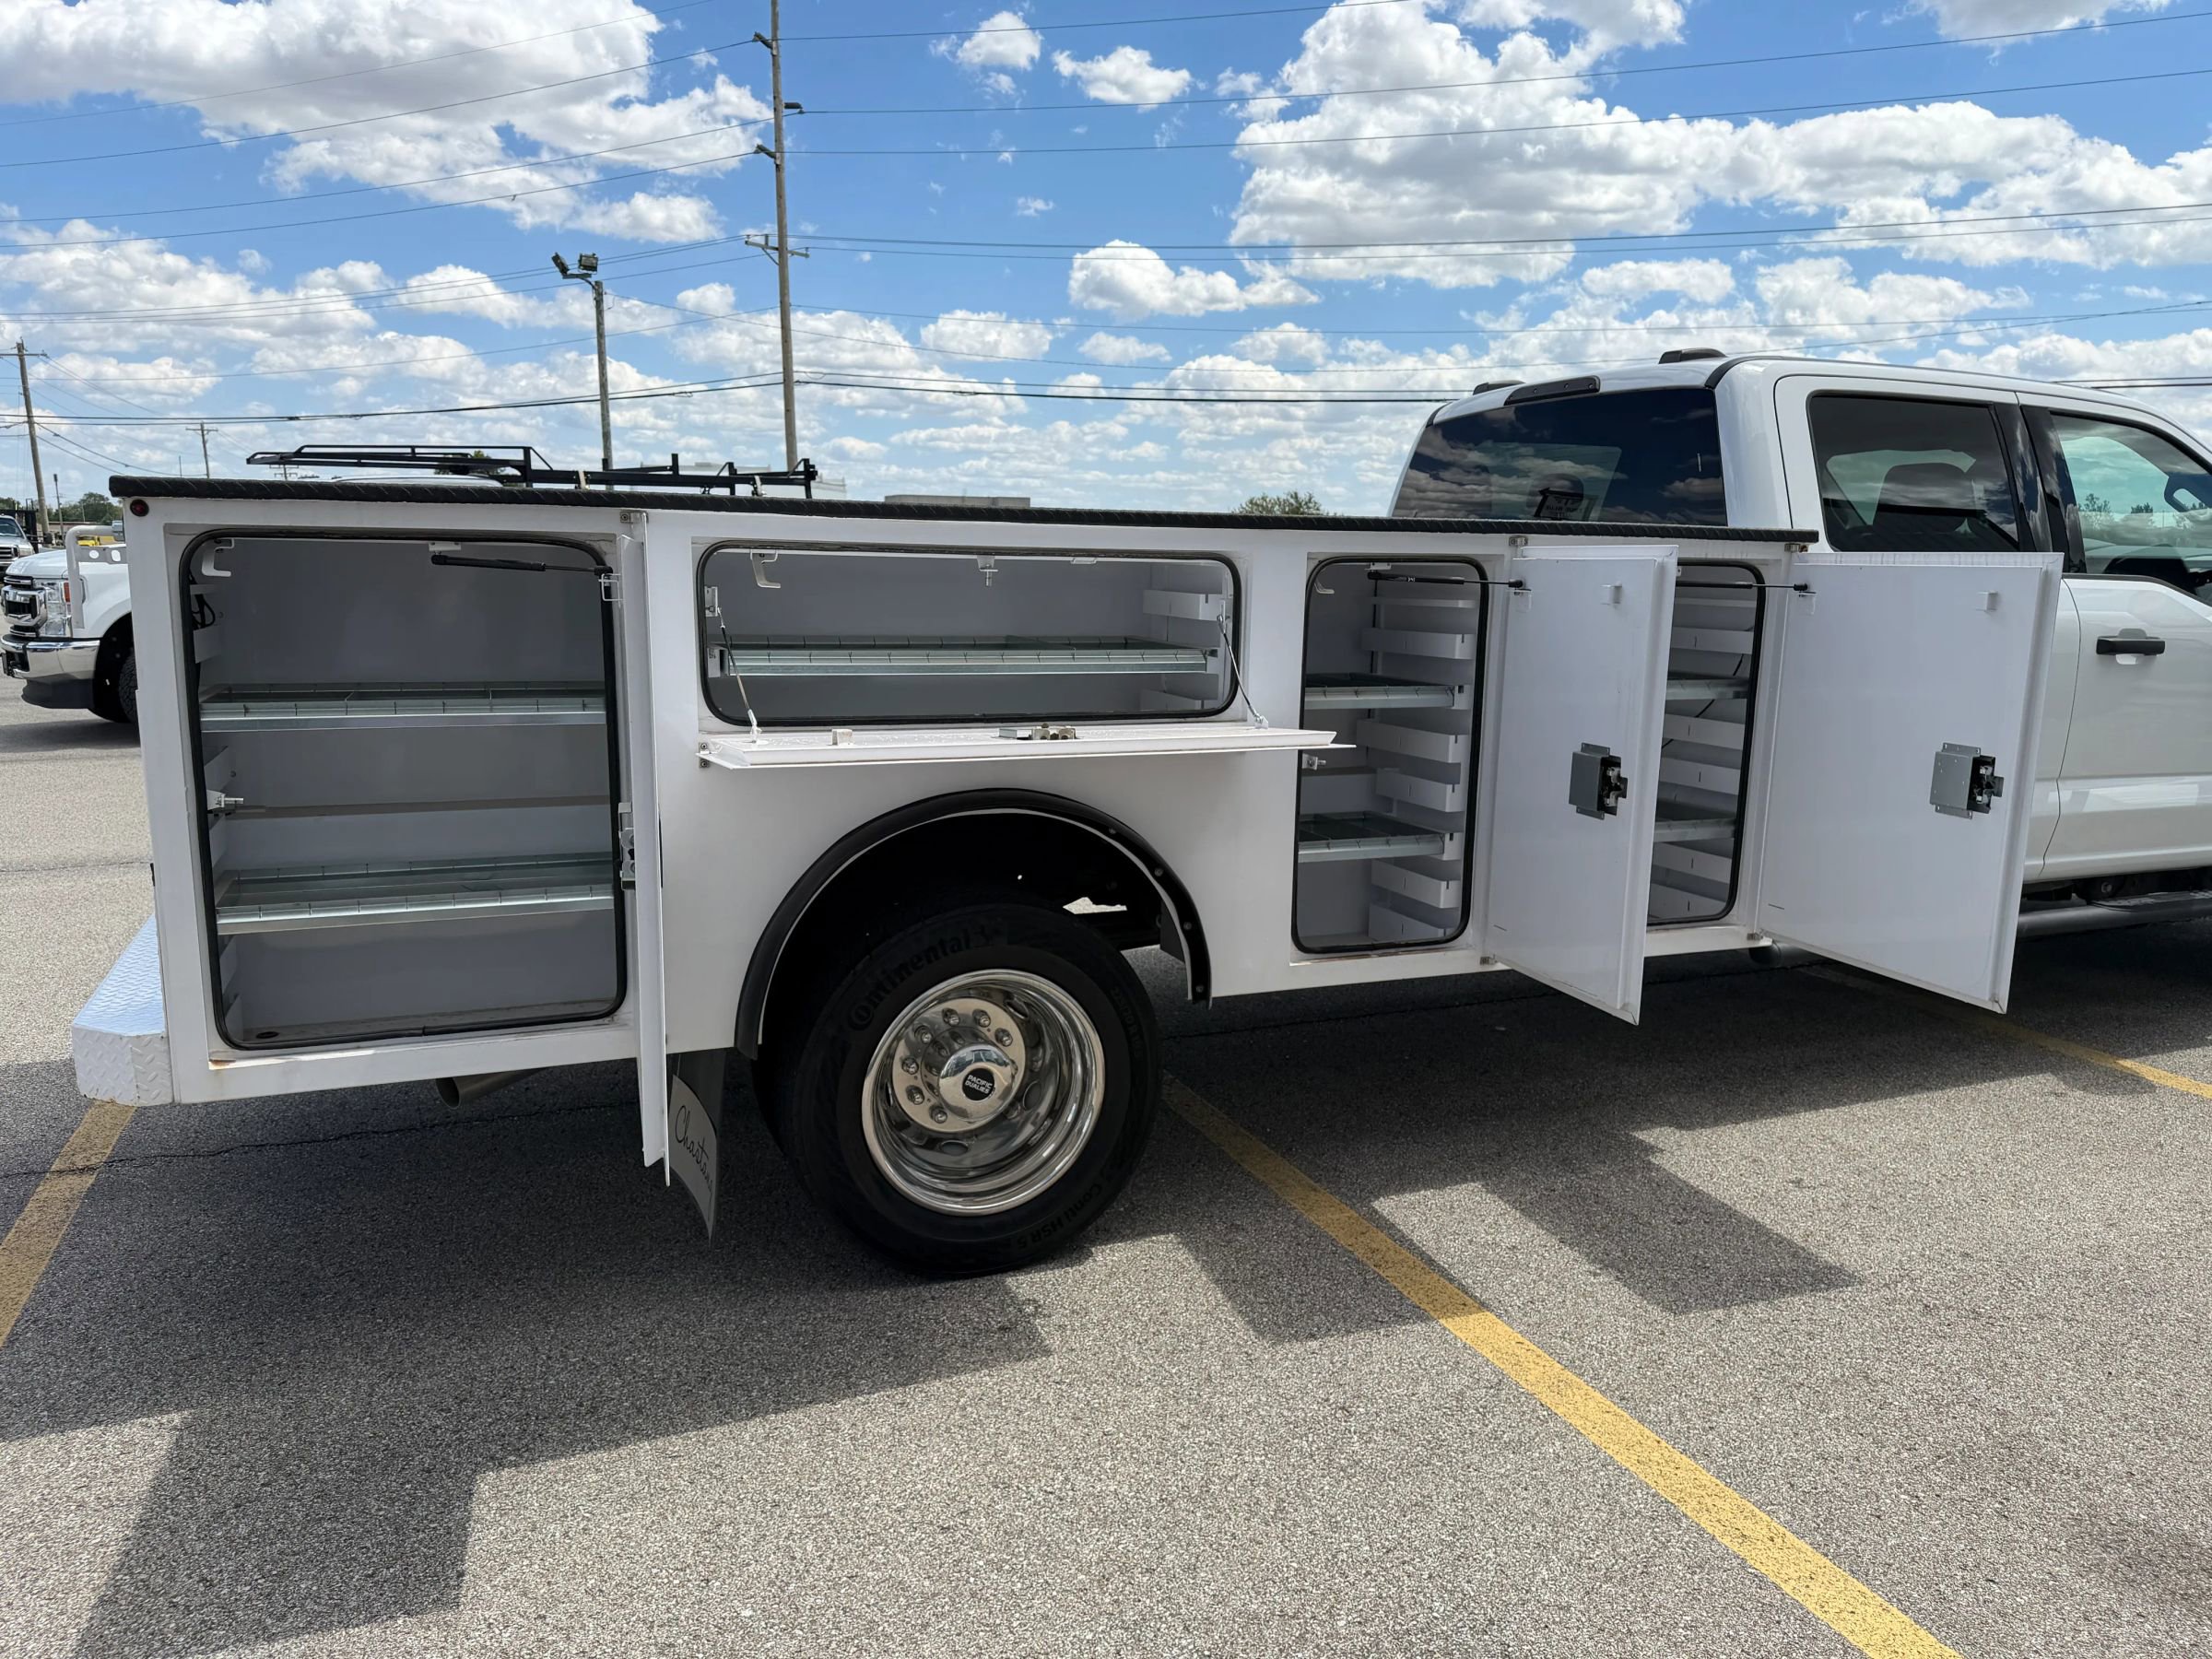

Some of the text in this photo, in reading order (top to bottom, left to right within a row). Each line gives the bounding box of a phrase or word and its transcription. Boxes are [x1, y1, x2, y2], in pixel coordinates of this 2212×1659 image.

[847, 930, 971, 1030] Continental
[964, 1079, 990, 1094] DUALIES
[967, 1074, 993, 1089] PACIFIC
[1064, 1183, 1103, 1222] Conti
